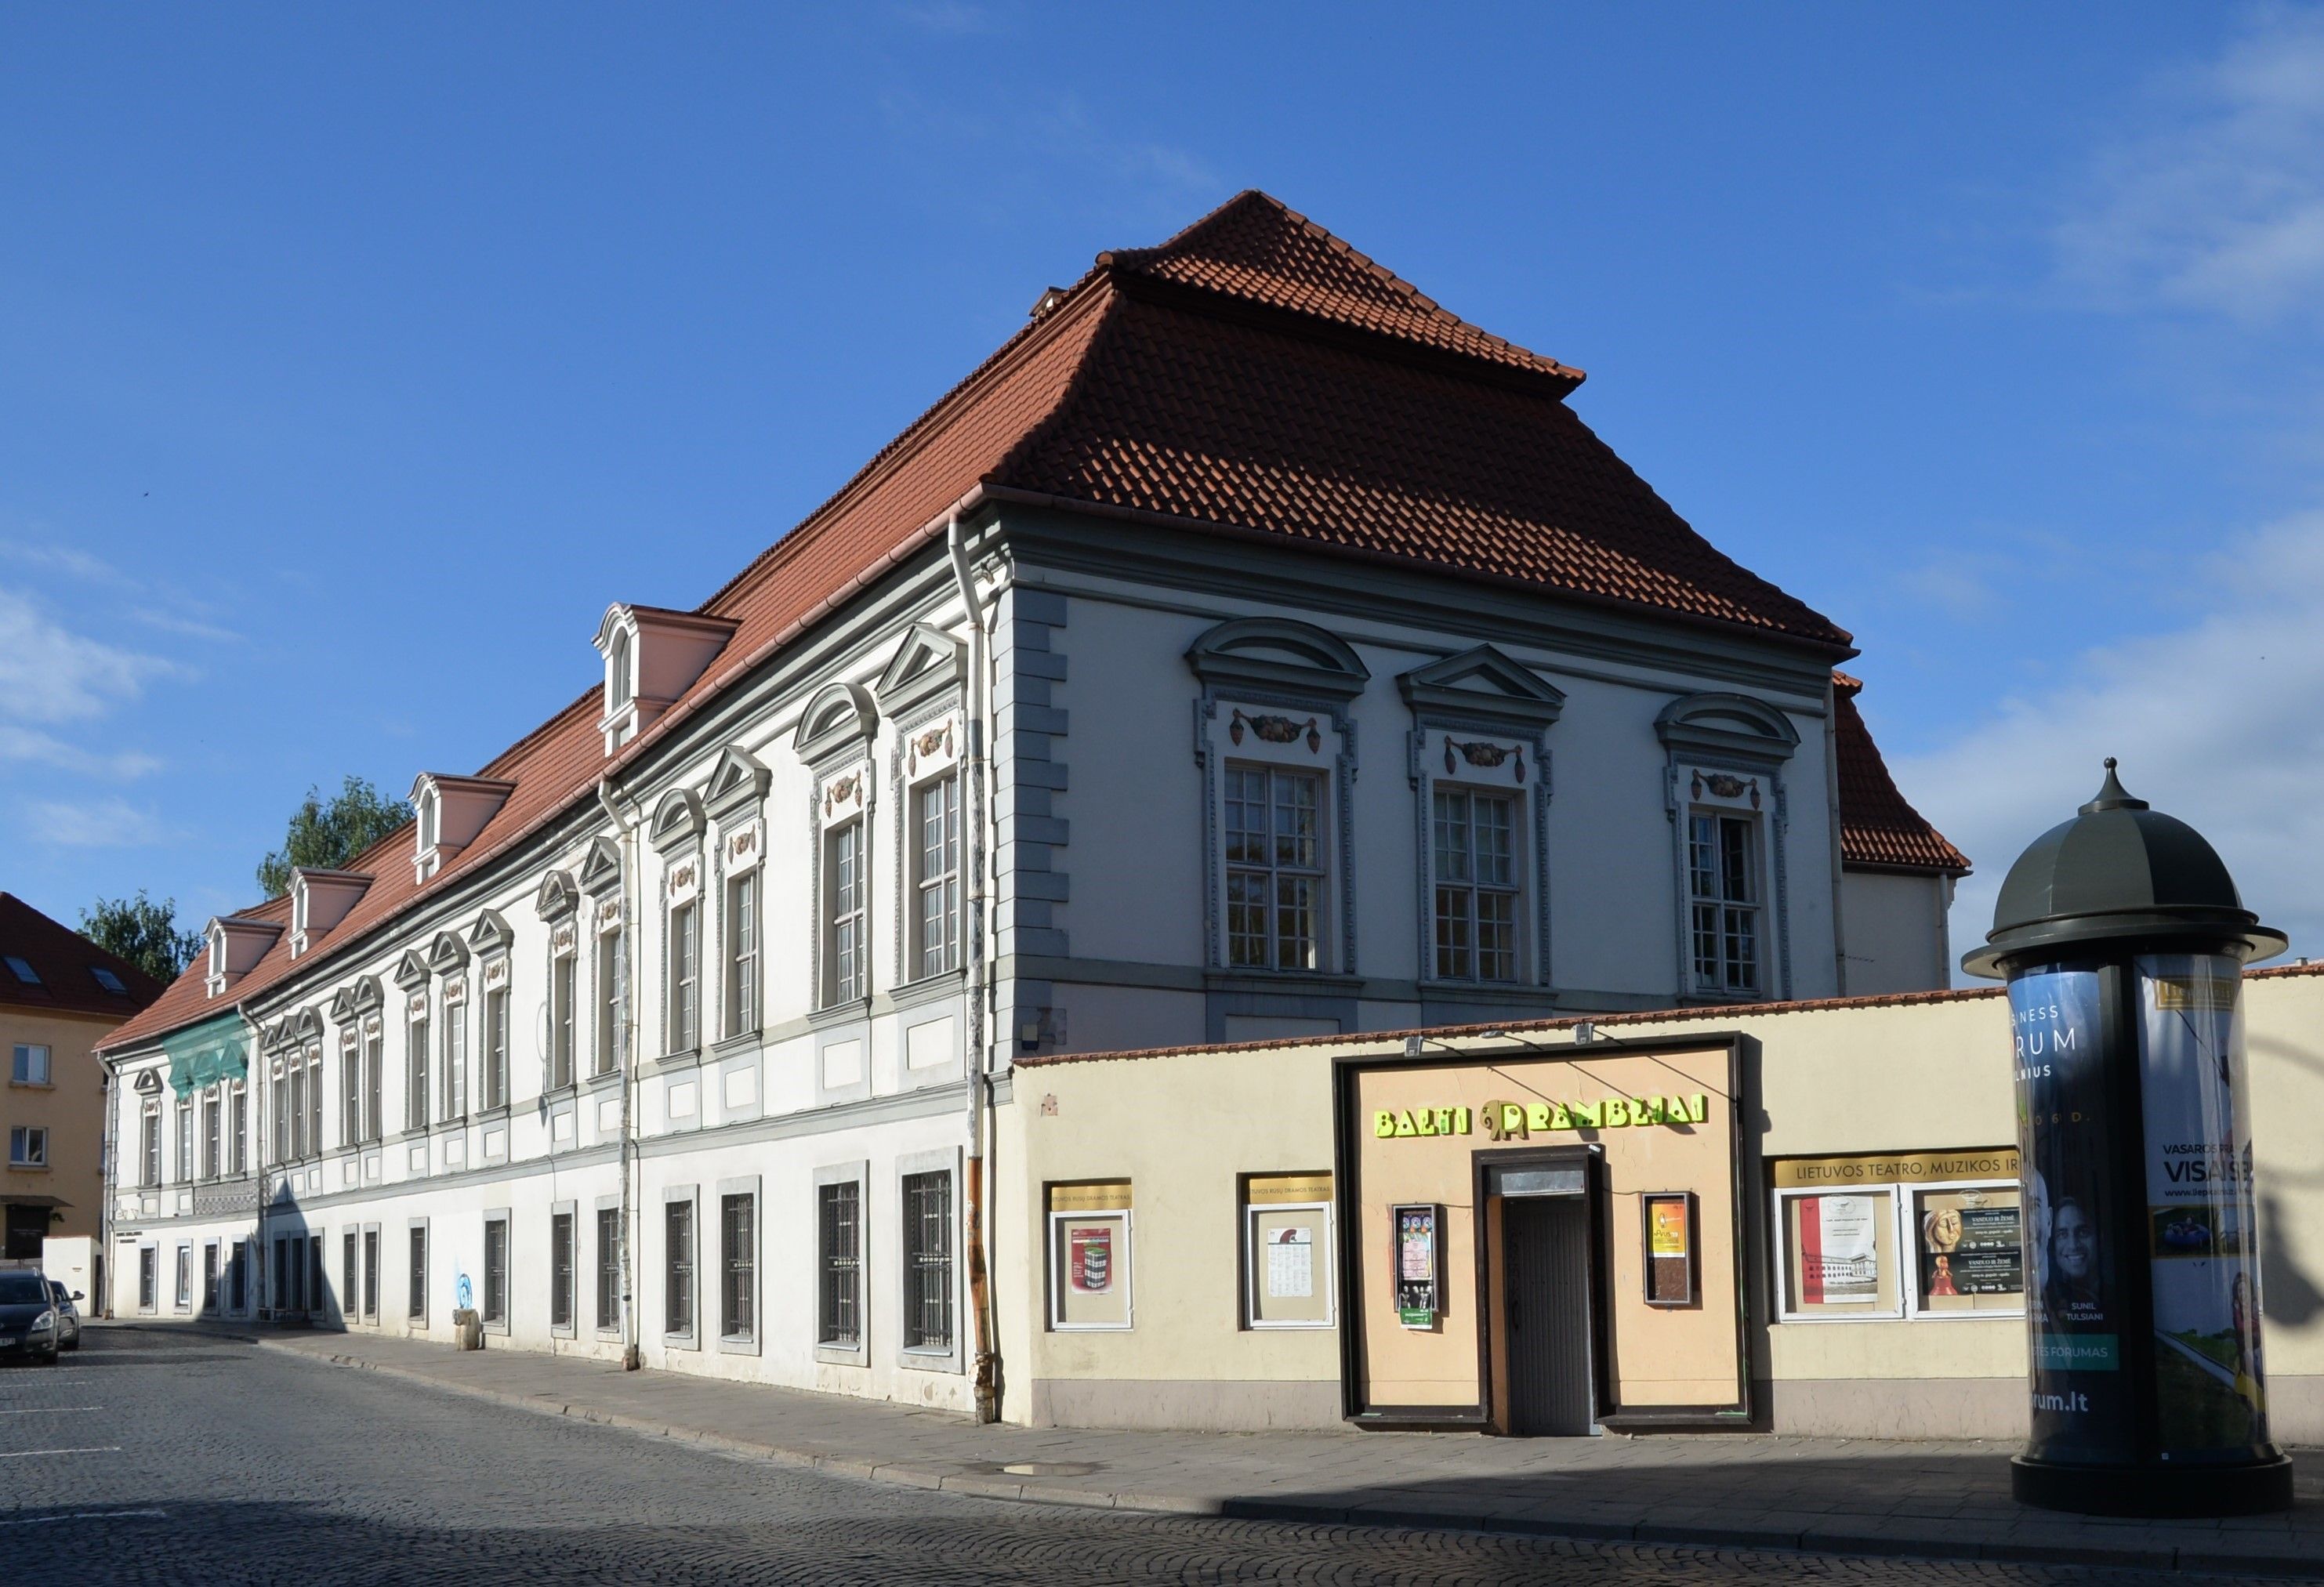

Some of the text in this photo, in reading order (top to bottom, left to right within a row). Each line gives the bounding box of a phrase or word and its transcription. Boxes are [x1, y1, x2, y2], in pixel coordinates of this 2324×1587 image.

[2016, 1027, 2076, 1058] RUM
[1374, 1093, 1709, 1137] BALTI DRAMBLIAI
[2163, 1144, 2217, 1154] VASAROS
[1796, 1158, 2018, 1179] LIETUVOS TEATRO, MUZIKOS IR
[2066, 1313, 2104, 1321] TULSIANI
[2050, 1346, 2108, 1357] FORUMAS
[2033, 1391, 2088, 1411] rum.lt
